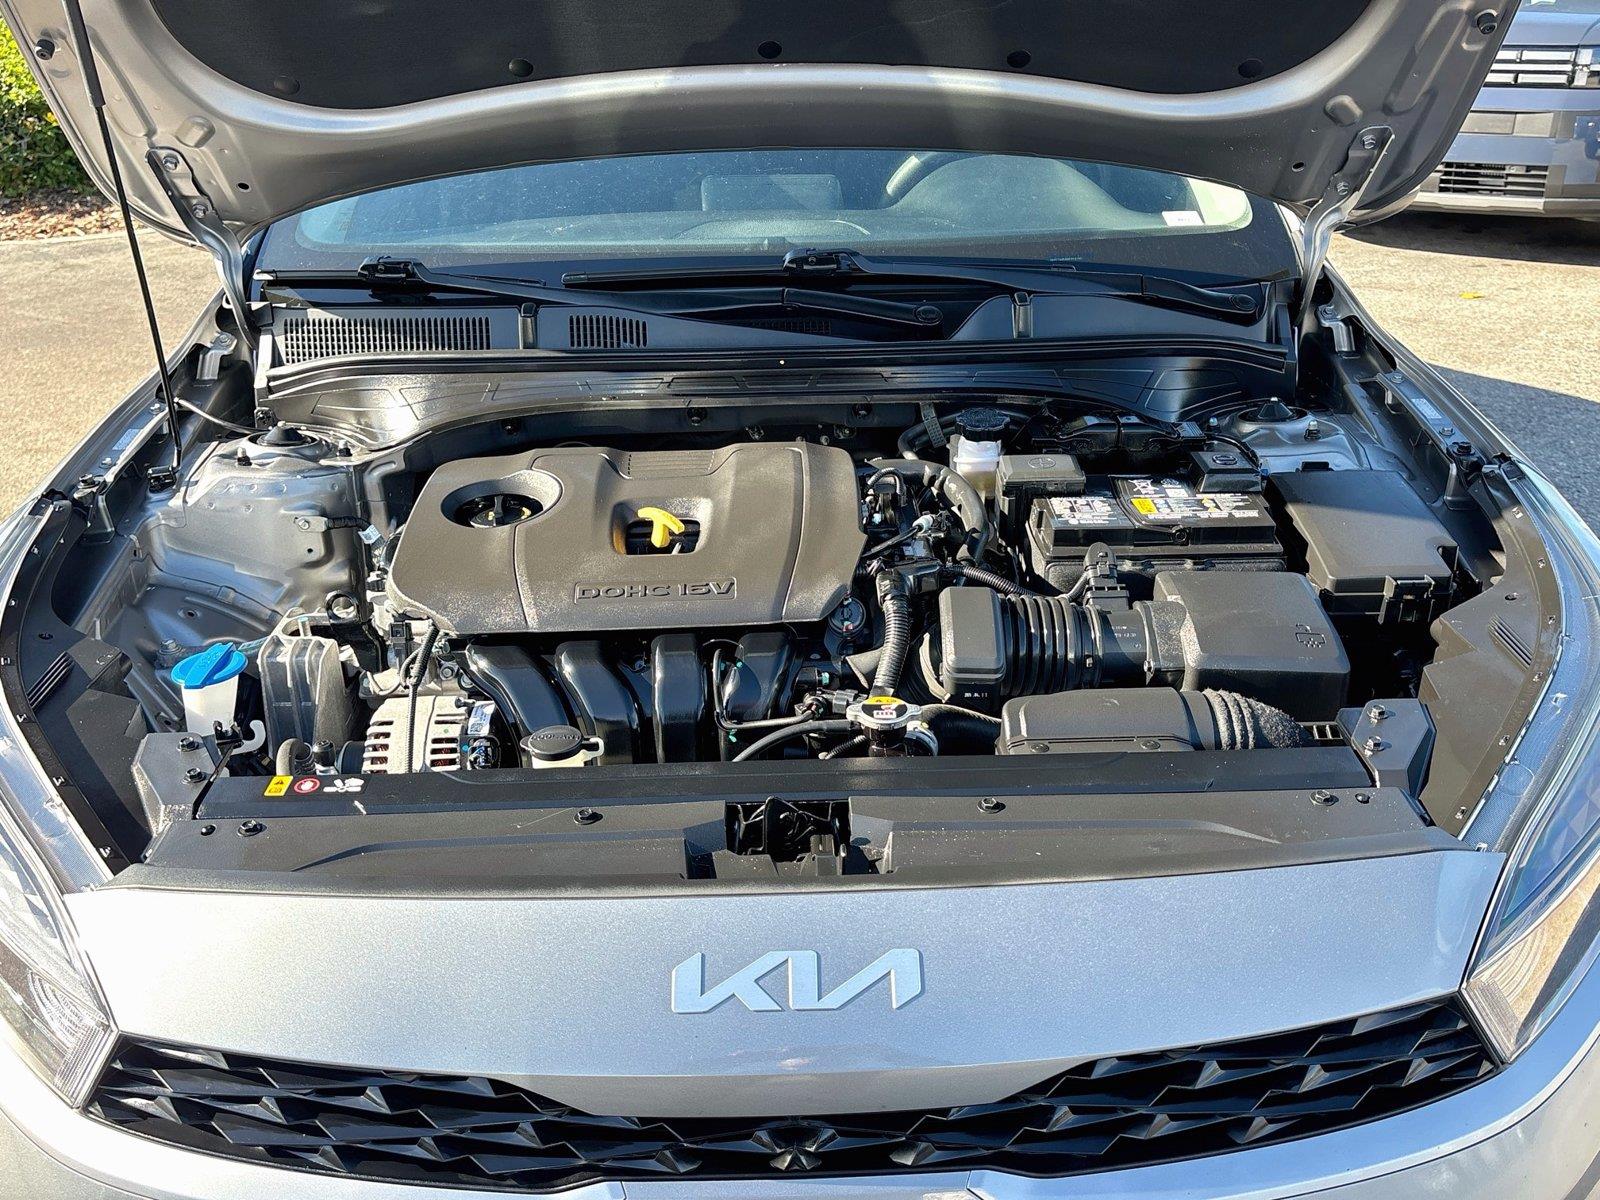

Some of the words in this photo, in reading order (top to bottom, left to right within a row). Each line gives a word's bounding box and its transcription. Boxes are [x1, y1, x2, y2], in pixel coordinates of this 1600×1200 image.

[577, 584, 671, 600] DOHC
[678, 581, 735, 597] 16V
[671, 948, 922, 1013] KIA
